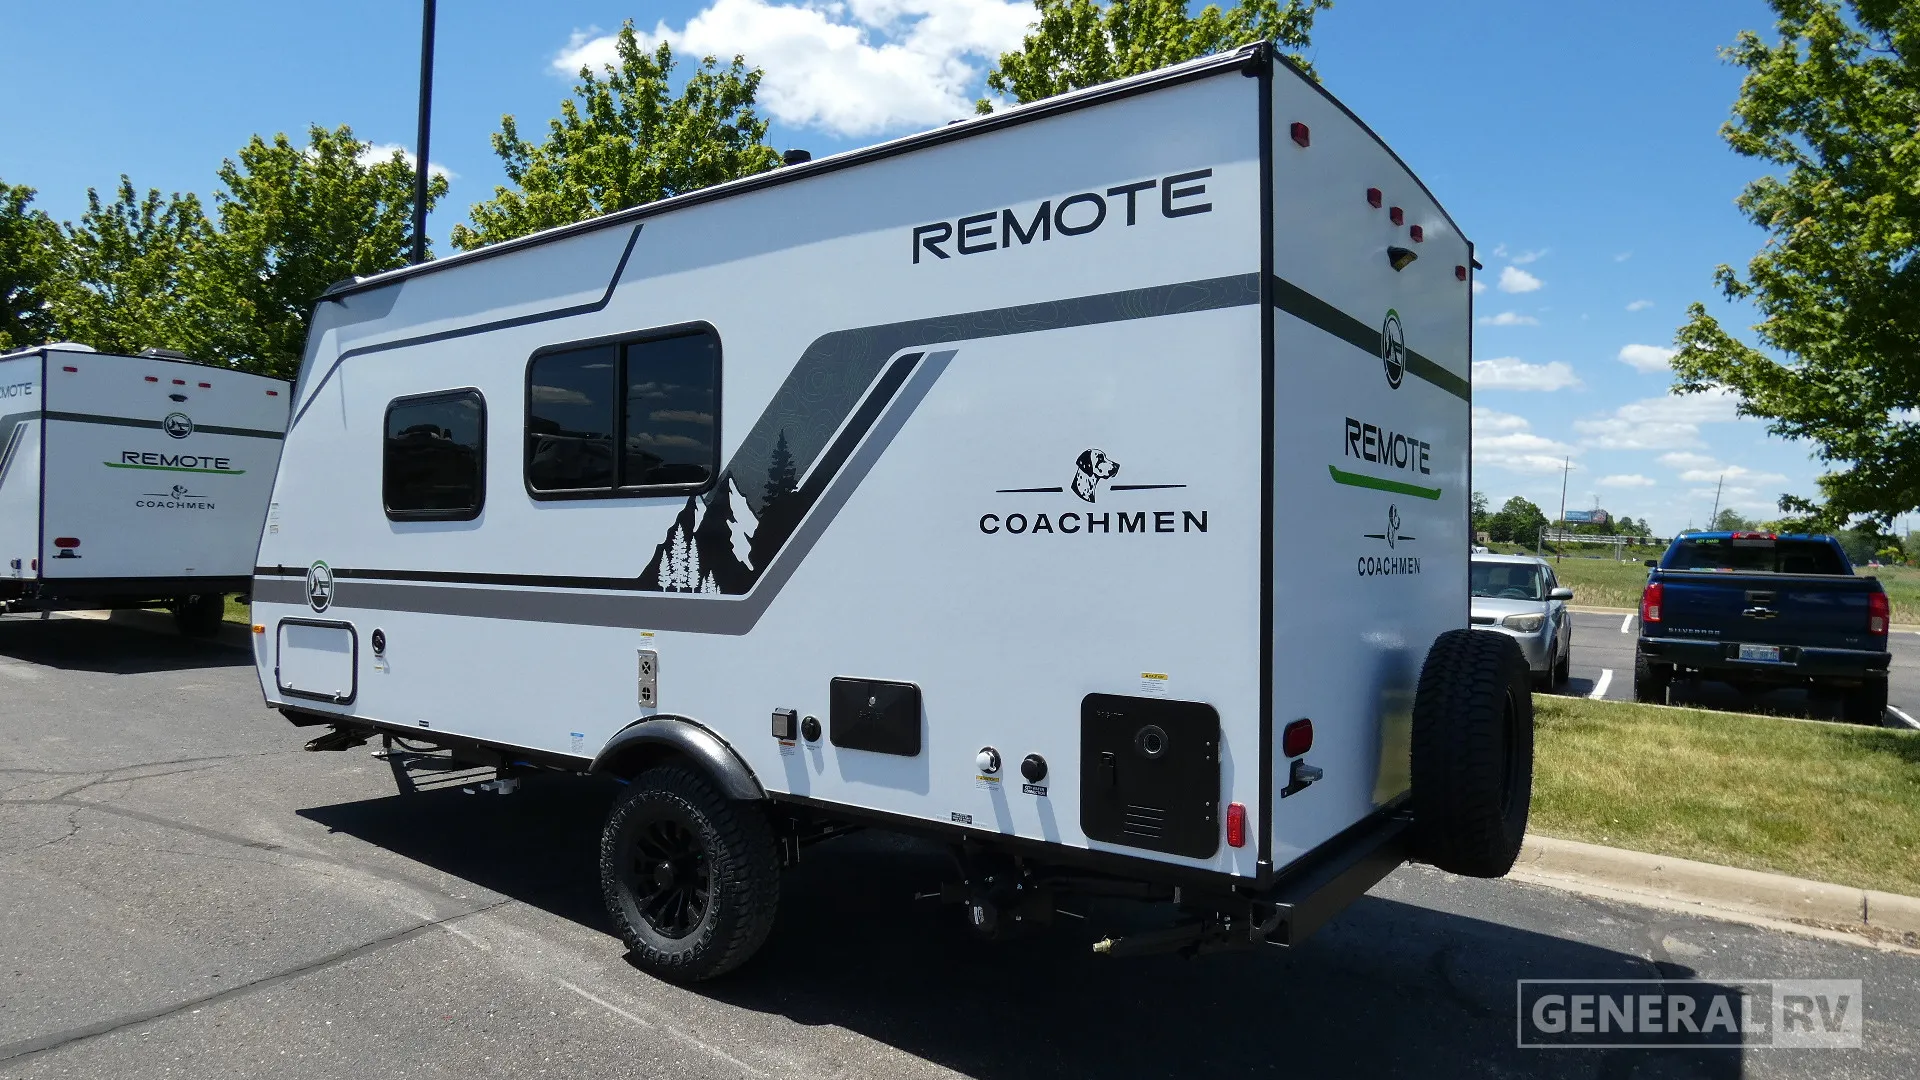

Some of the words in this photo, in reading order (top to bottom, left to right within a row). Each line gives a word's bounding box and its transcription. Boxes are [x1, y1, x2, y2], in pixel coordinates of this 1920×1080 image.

[913, 168, 1212, 264] REMOTE
[1345, 416, 1430, 475] REMOTE
[122, 451, 230, 469] REMOTE
[136, 500, 215, 510] COACHMEN
[980, 511, 1207, 534] COACHMEN
[1358, 556, 1421, 577] COACHMEN
[1668, 627, 1721, 635] SILVERADO
